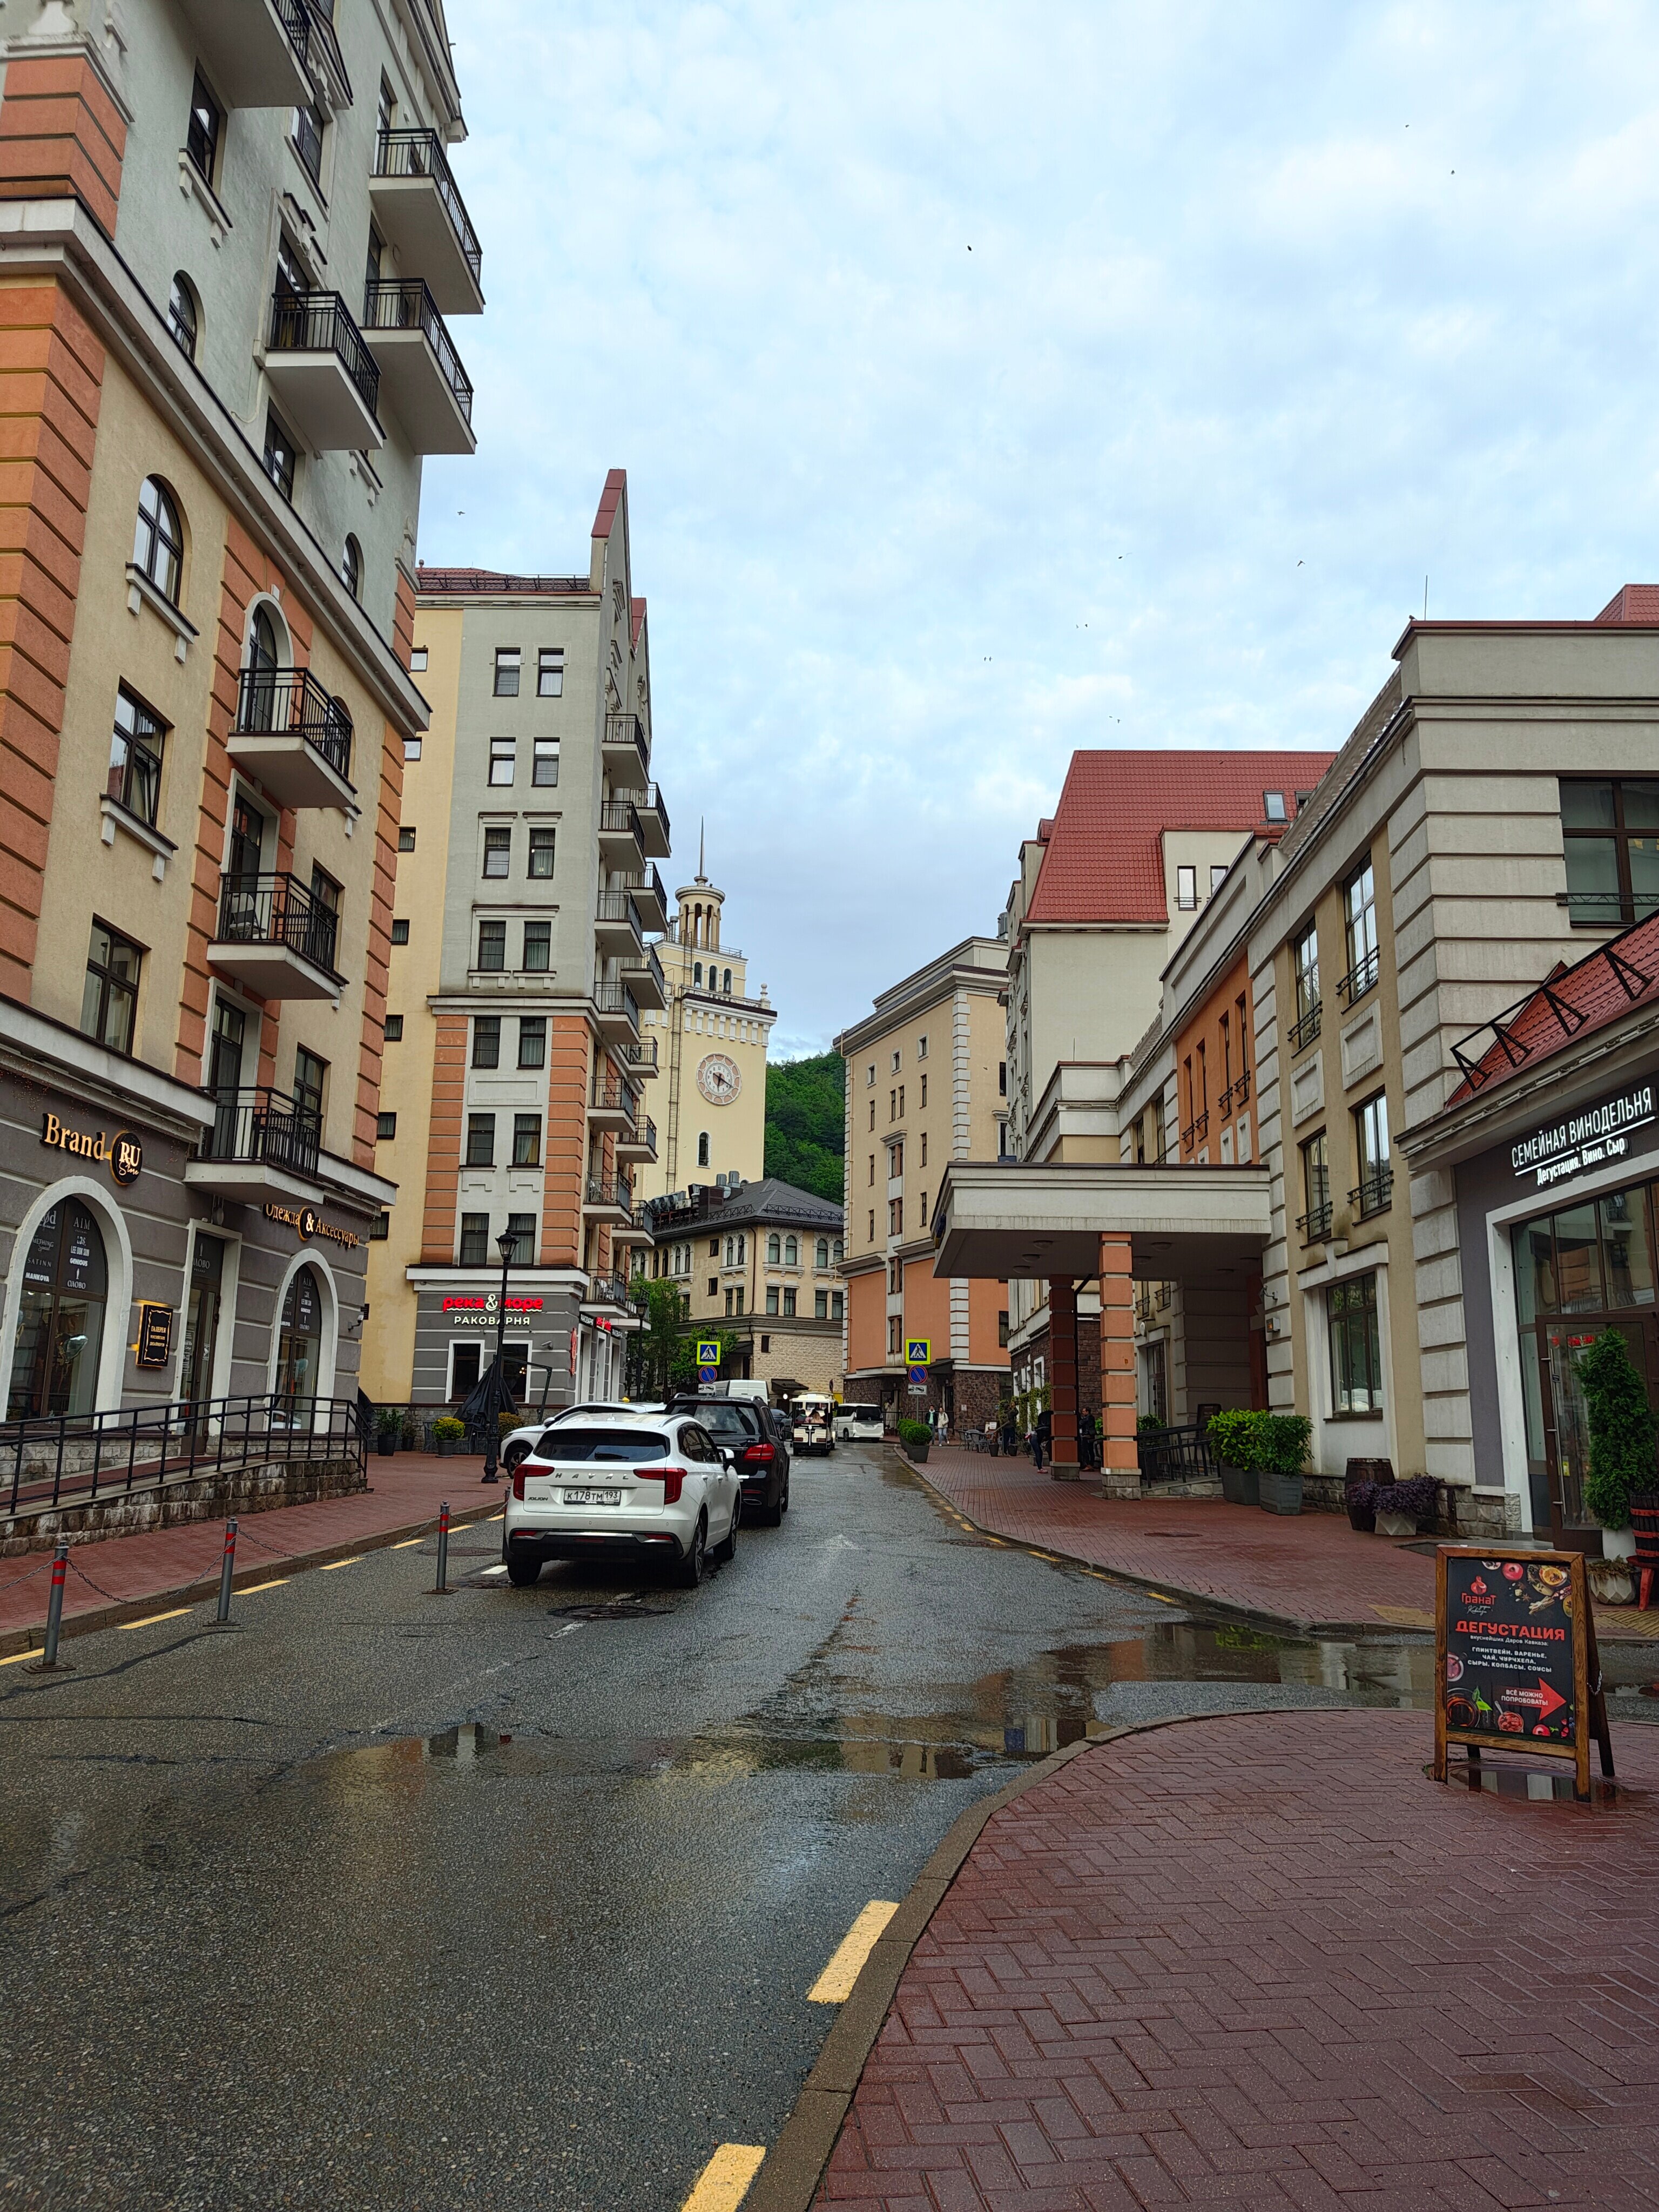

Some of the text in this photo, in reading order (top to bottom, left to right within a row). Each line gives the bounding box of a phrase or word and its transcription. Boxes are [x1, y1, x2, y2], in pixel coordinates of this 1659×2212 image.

[1512, 1087, 1652, 1168] СЕМЕЙНАЯ ВИНОДЕЛЬНЯ
[44, 1113, 141, 1167] Brand RU
[1537, 1138, 1625, 1186] Дегустация. Вино. Сыр
[118, 1161, 139, 1176] Store
[73, 1217, 90, 1230] AIM
[266, 1204, 359, 1249] Одежда & Аксессуары
[28, 1258, 52, 1267] SATINN
[70, 1258, 88, 1267] GENIOUS
[193, 1258, 210, 1269] ЛОВО
[25, 1272, 50, 1282] MANKOVA
[443, 1297, 484, 1313] река
[454, 1316, 530, 1325] РАКОВРНЯ
[1461, 1593, 1496, 1605] Гранат
[1455, 1620, 1564, 1641] ДЕГУСТАЦИЯ
[1514, 1650, 1547, 1659] ВАРЕНЬЕ,
[1501, 1695, 1548, 1705] ПОПРОБОВАТЬ!
